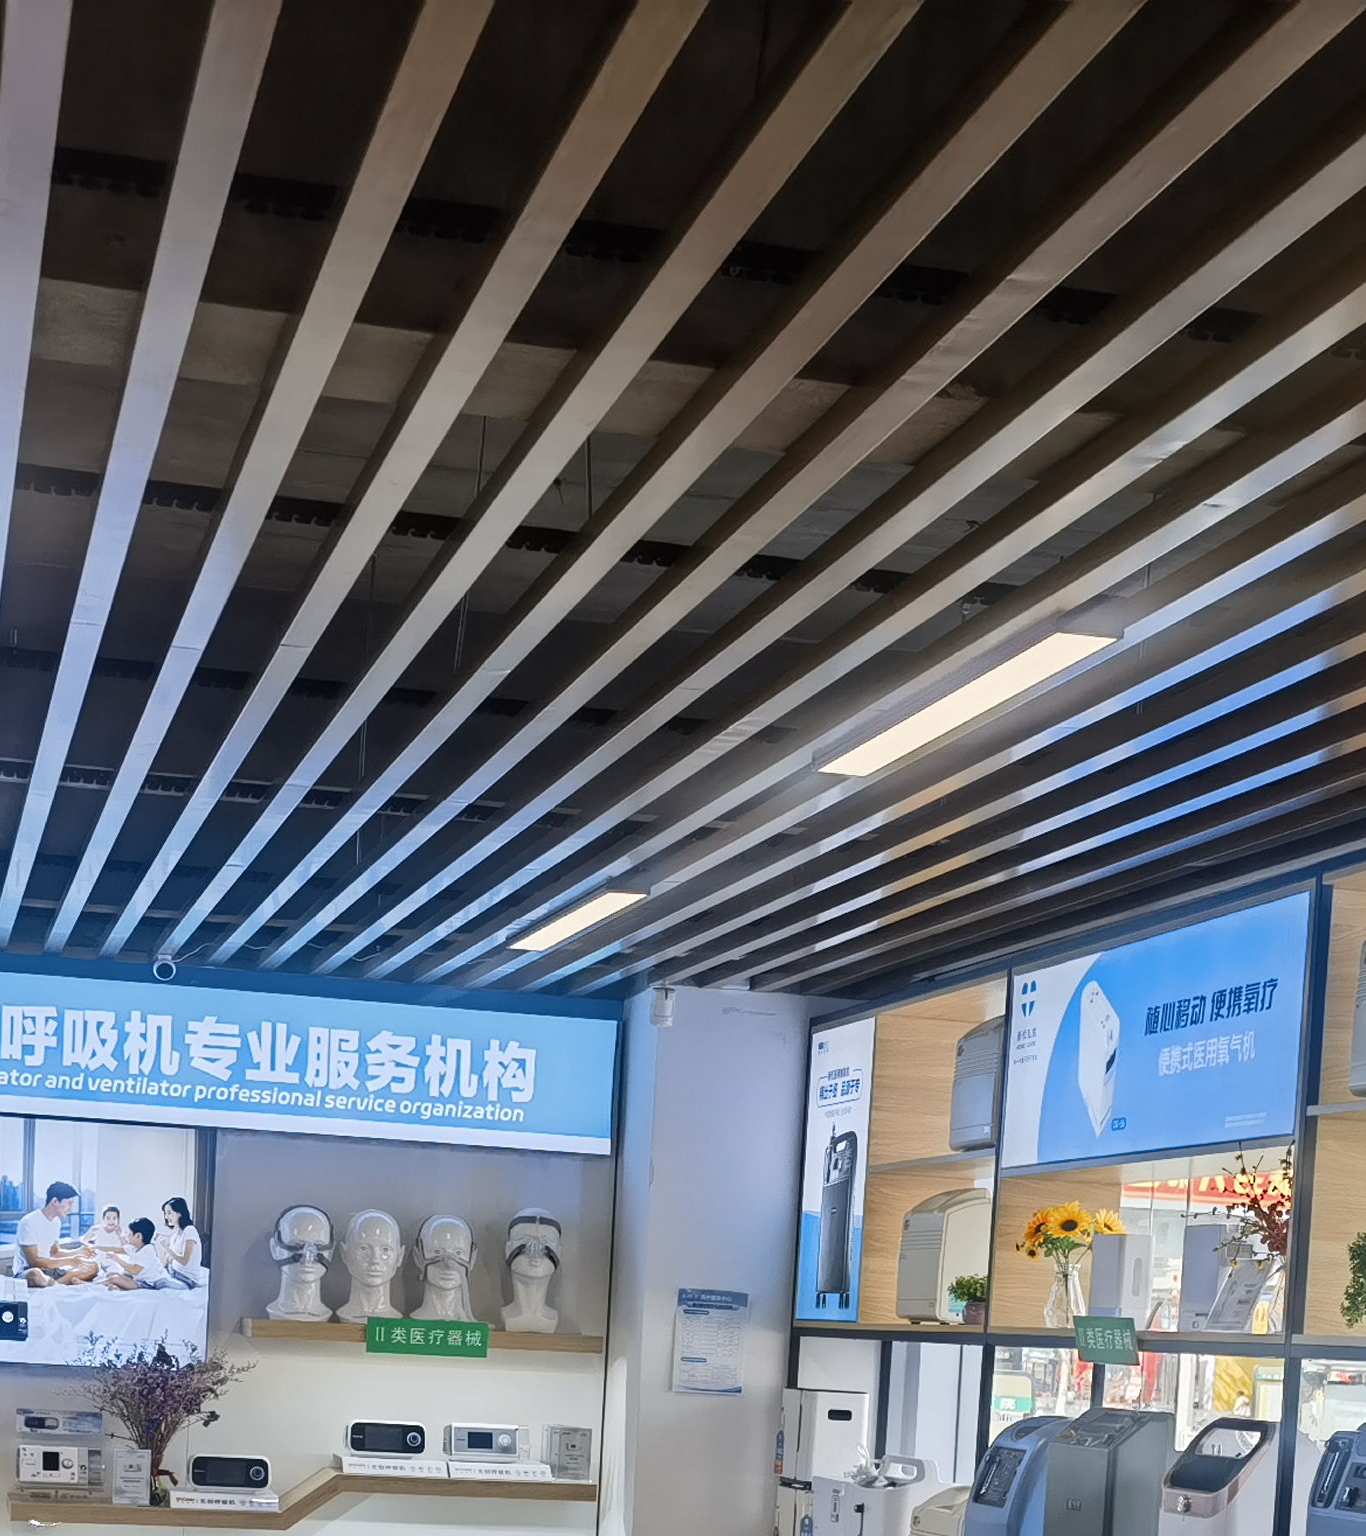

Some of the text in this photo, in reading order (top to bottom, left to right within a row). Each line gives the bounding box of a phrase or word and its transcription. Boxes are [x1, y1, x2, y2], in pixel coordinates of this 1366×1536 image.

[1145, 977, 1278, 1036] 随心移动 便携氧疗
[1157, 1031, 1256, 1077] 便携式医用氧气机
[45, 1073, 83, 1091] and
[88, 1075, 192, 1098] ventilator
[194, 1084, 322, 1108] professional
[325, 1096, 397, 1114] service
[400, 1101, 525, 1123] organization
[390, 1325, 482, 1348] 类医疗器械
